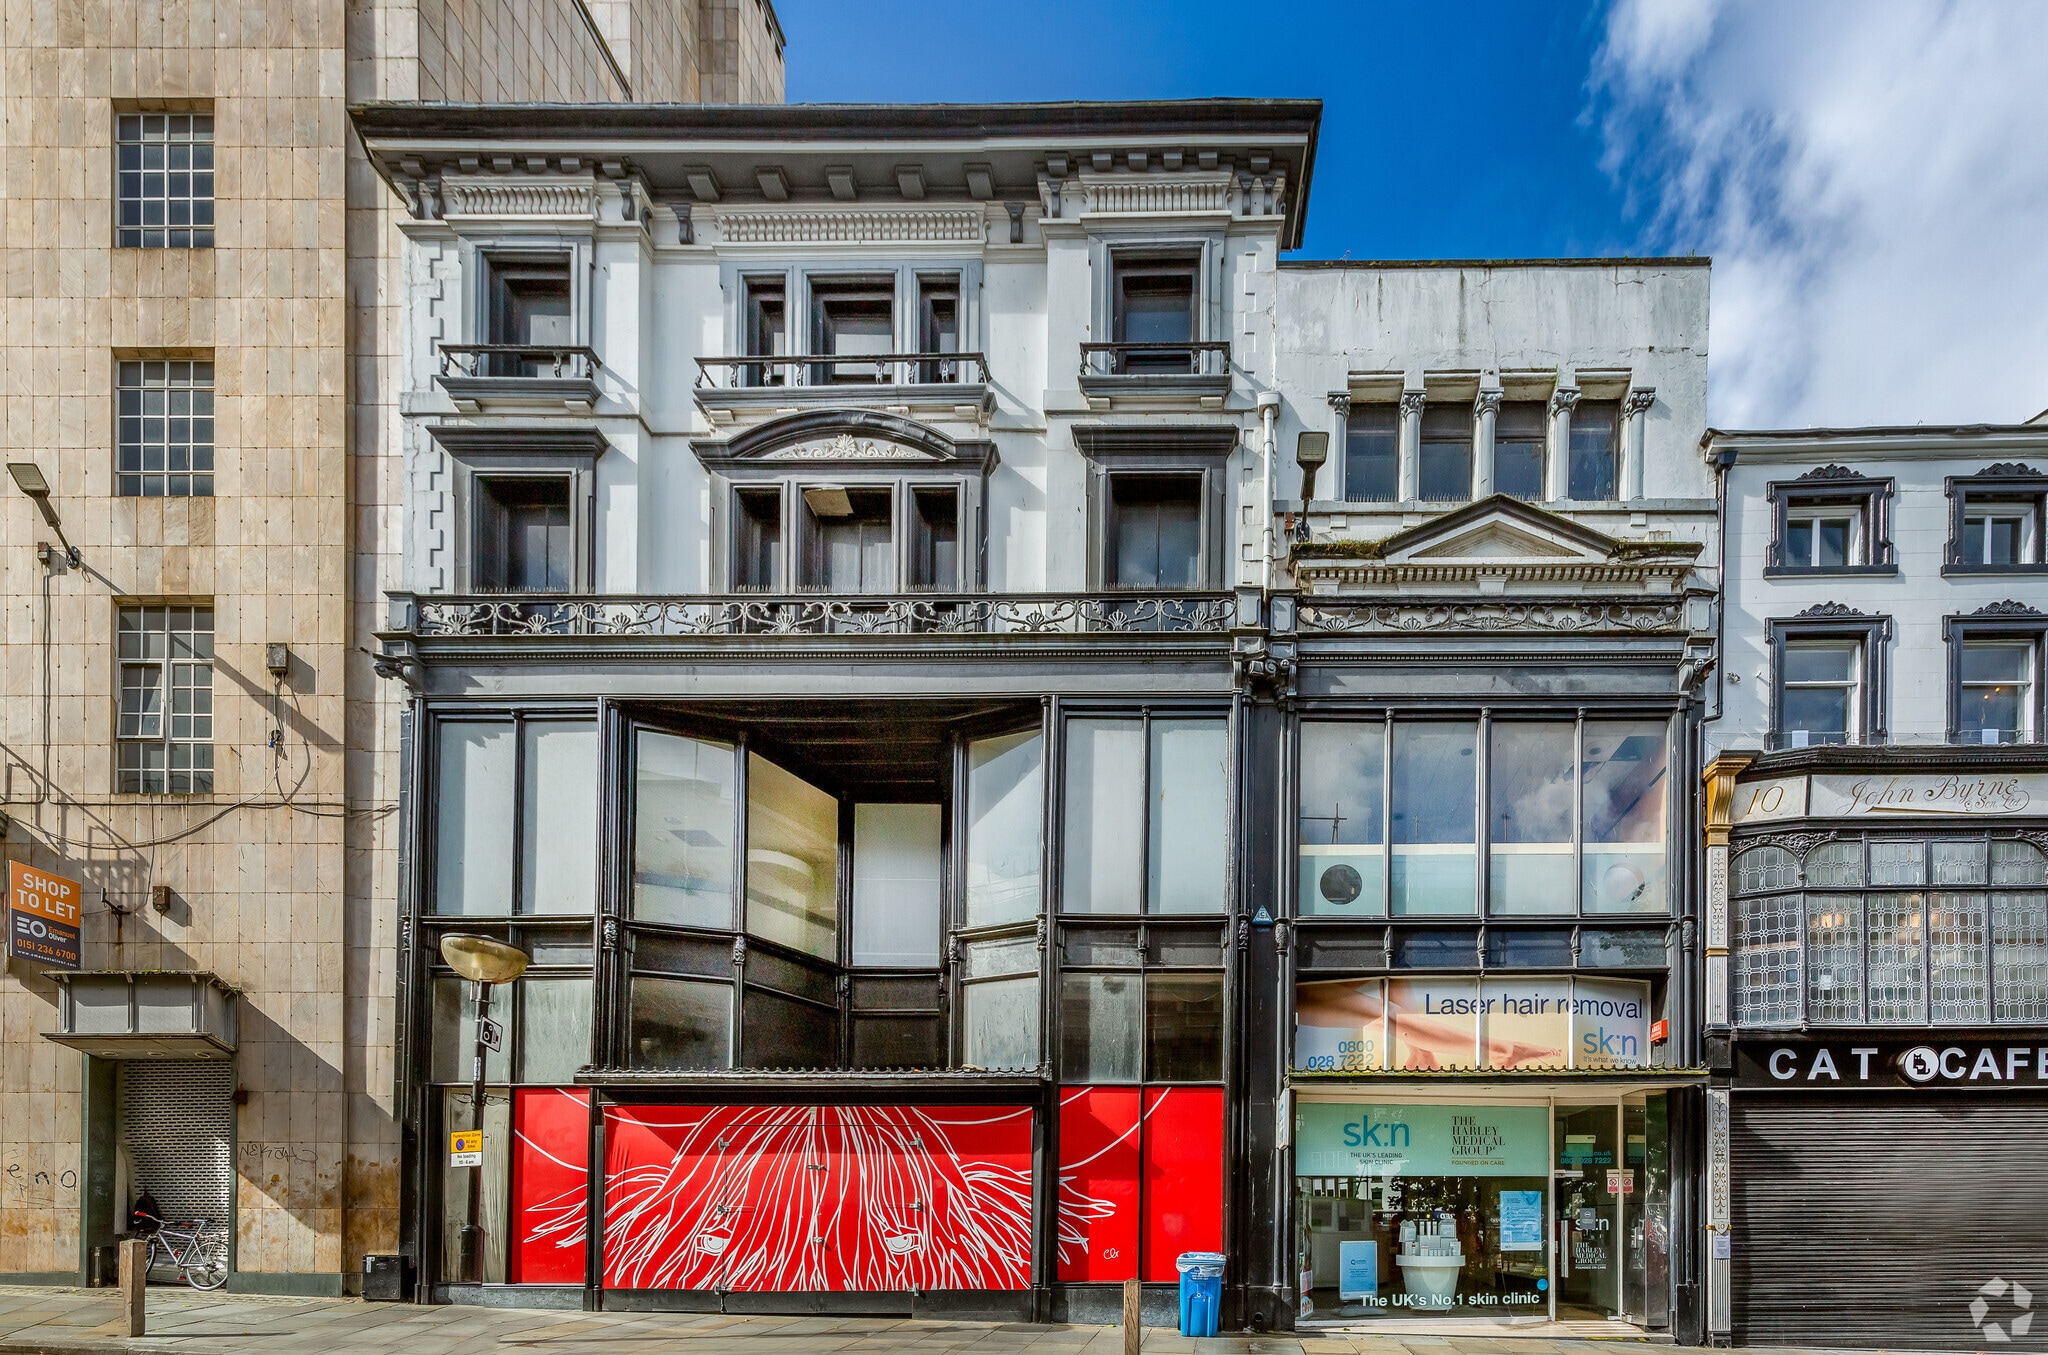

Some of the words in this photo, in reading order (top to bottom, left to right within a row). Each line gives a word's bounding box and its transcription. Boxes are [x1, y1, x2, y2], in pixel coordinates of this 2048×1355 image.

[1747, 786, 1785, 814] 10
[1838, 777, 1916, 815] John
[23, 873, 70, 898] SHOP
[17, 889, 39, 908] TO
[45, 897, 76, 919] LET
[17, 938, 35, 950] 0151
[37, 943, 54, 955] 236
[55, 948, 77, 961] 6700
[48, 932, 68, 943] Oliver
[1425, 993, 1496, 1015] Laser
[1503, 993, 1549, 1015] hair
[1557, 998, 1643, 1019] removal
[1338, 1040, 1375, 1053] 0800
[1583, 1026, 1637, 1056] sk:n
[1308, 1055, 1335, 1068] 028
[1339, 1053, 1375, 1067] 7222
[1768, 1047, 1879, 1080] CAT
[1343, 1114, 1410, 1147] sk:n
[1452, 1116, 1476, 1126] THE
[1452, 1126, 1498, 1136] HARLEY
[1452, 1136, 1506, 1146] MEDICAL
[1360, 1294, 1388, 1307] The
[1392, 1293, 1427, 1306] UK's
[1431, 1293, 1463, 1305] No.1
[1468, 1292, 1498, 1305] skin
[1502, 1291, 1540, 1304] clinic
